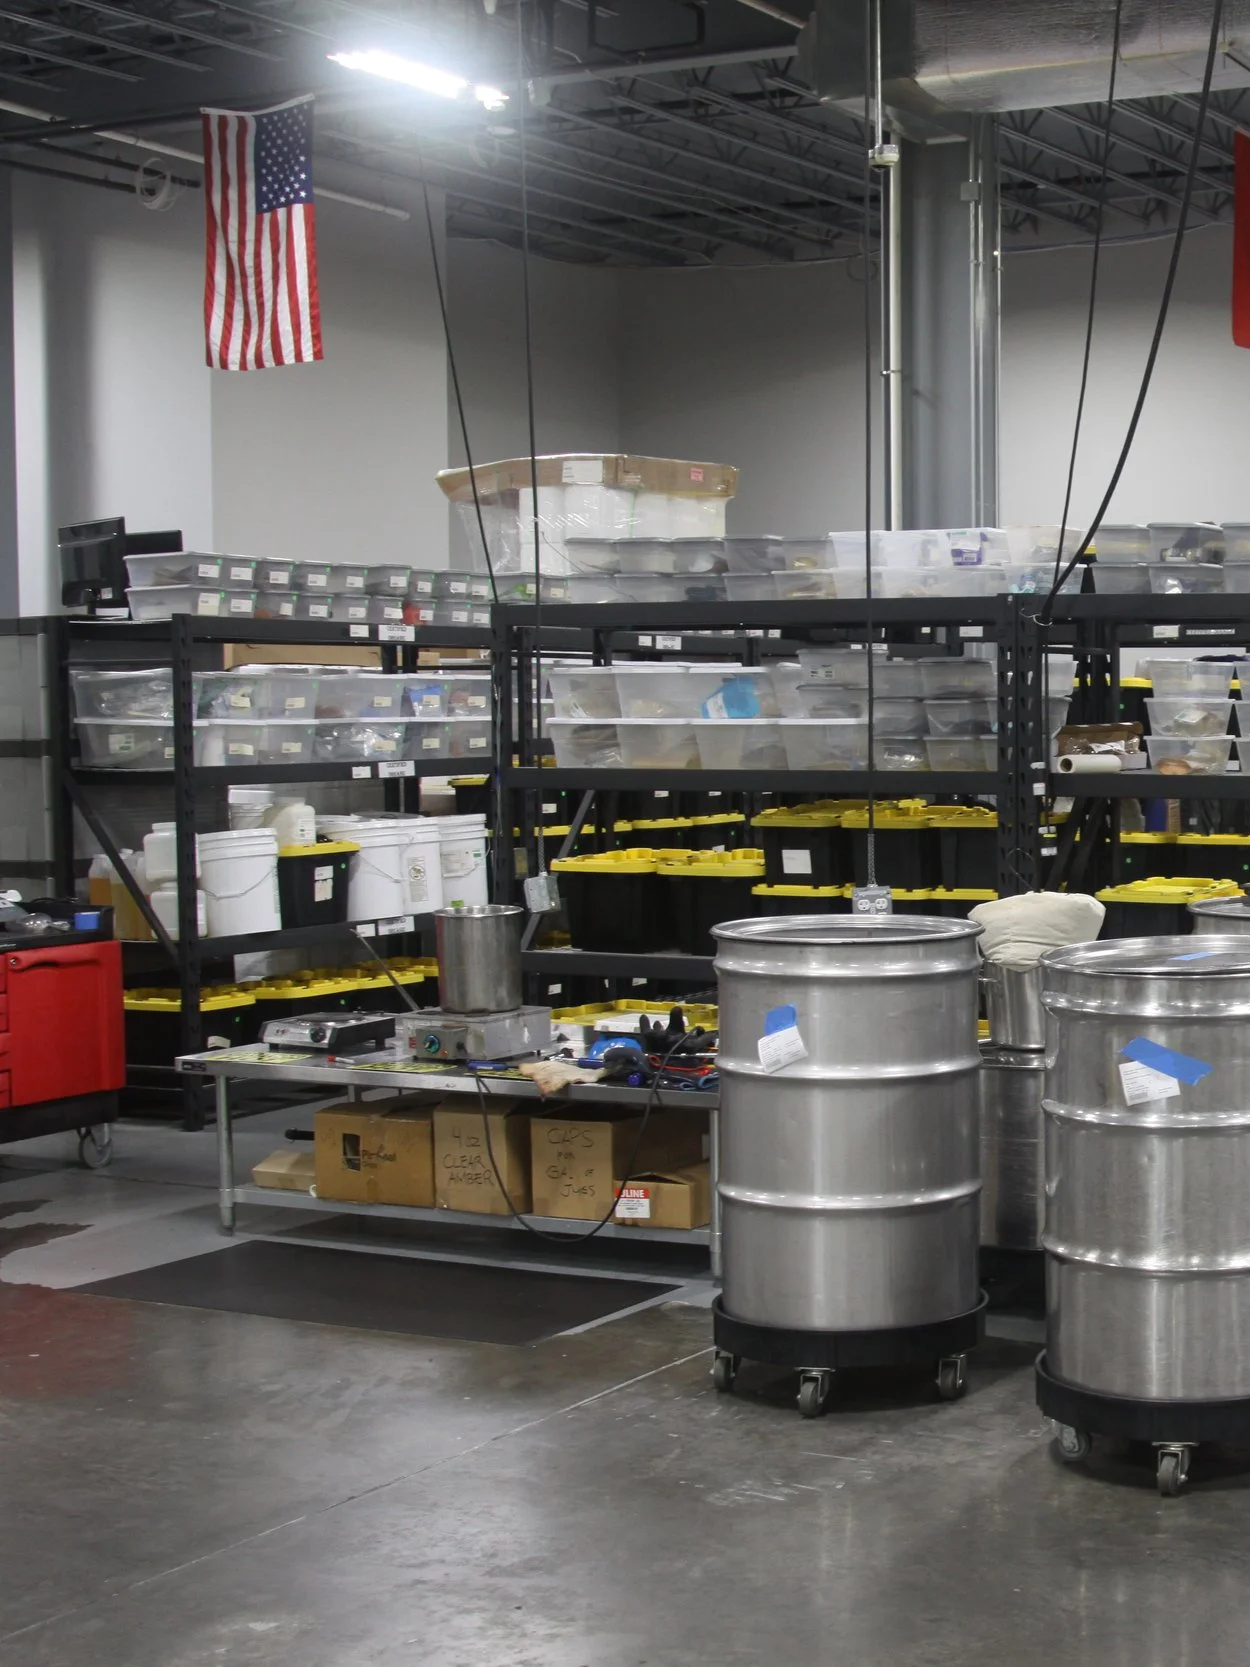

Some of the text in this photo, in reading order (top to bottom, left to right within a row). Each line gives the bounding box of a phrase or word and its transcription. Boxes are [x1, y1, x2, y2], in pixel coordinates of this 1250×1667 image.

[452, 1126, 462, 1147] 4
[547, 1127, 595, 1148] CAPS
[442, 1153, 486, 1170] CLEAR
[449, 1170, 496, 1188] AMBER
